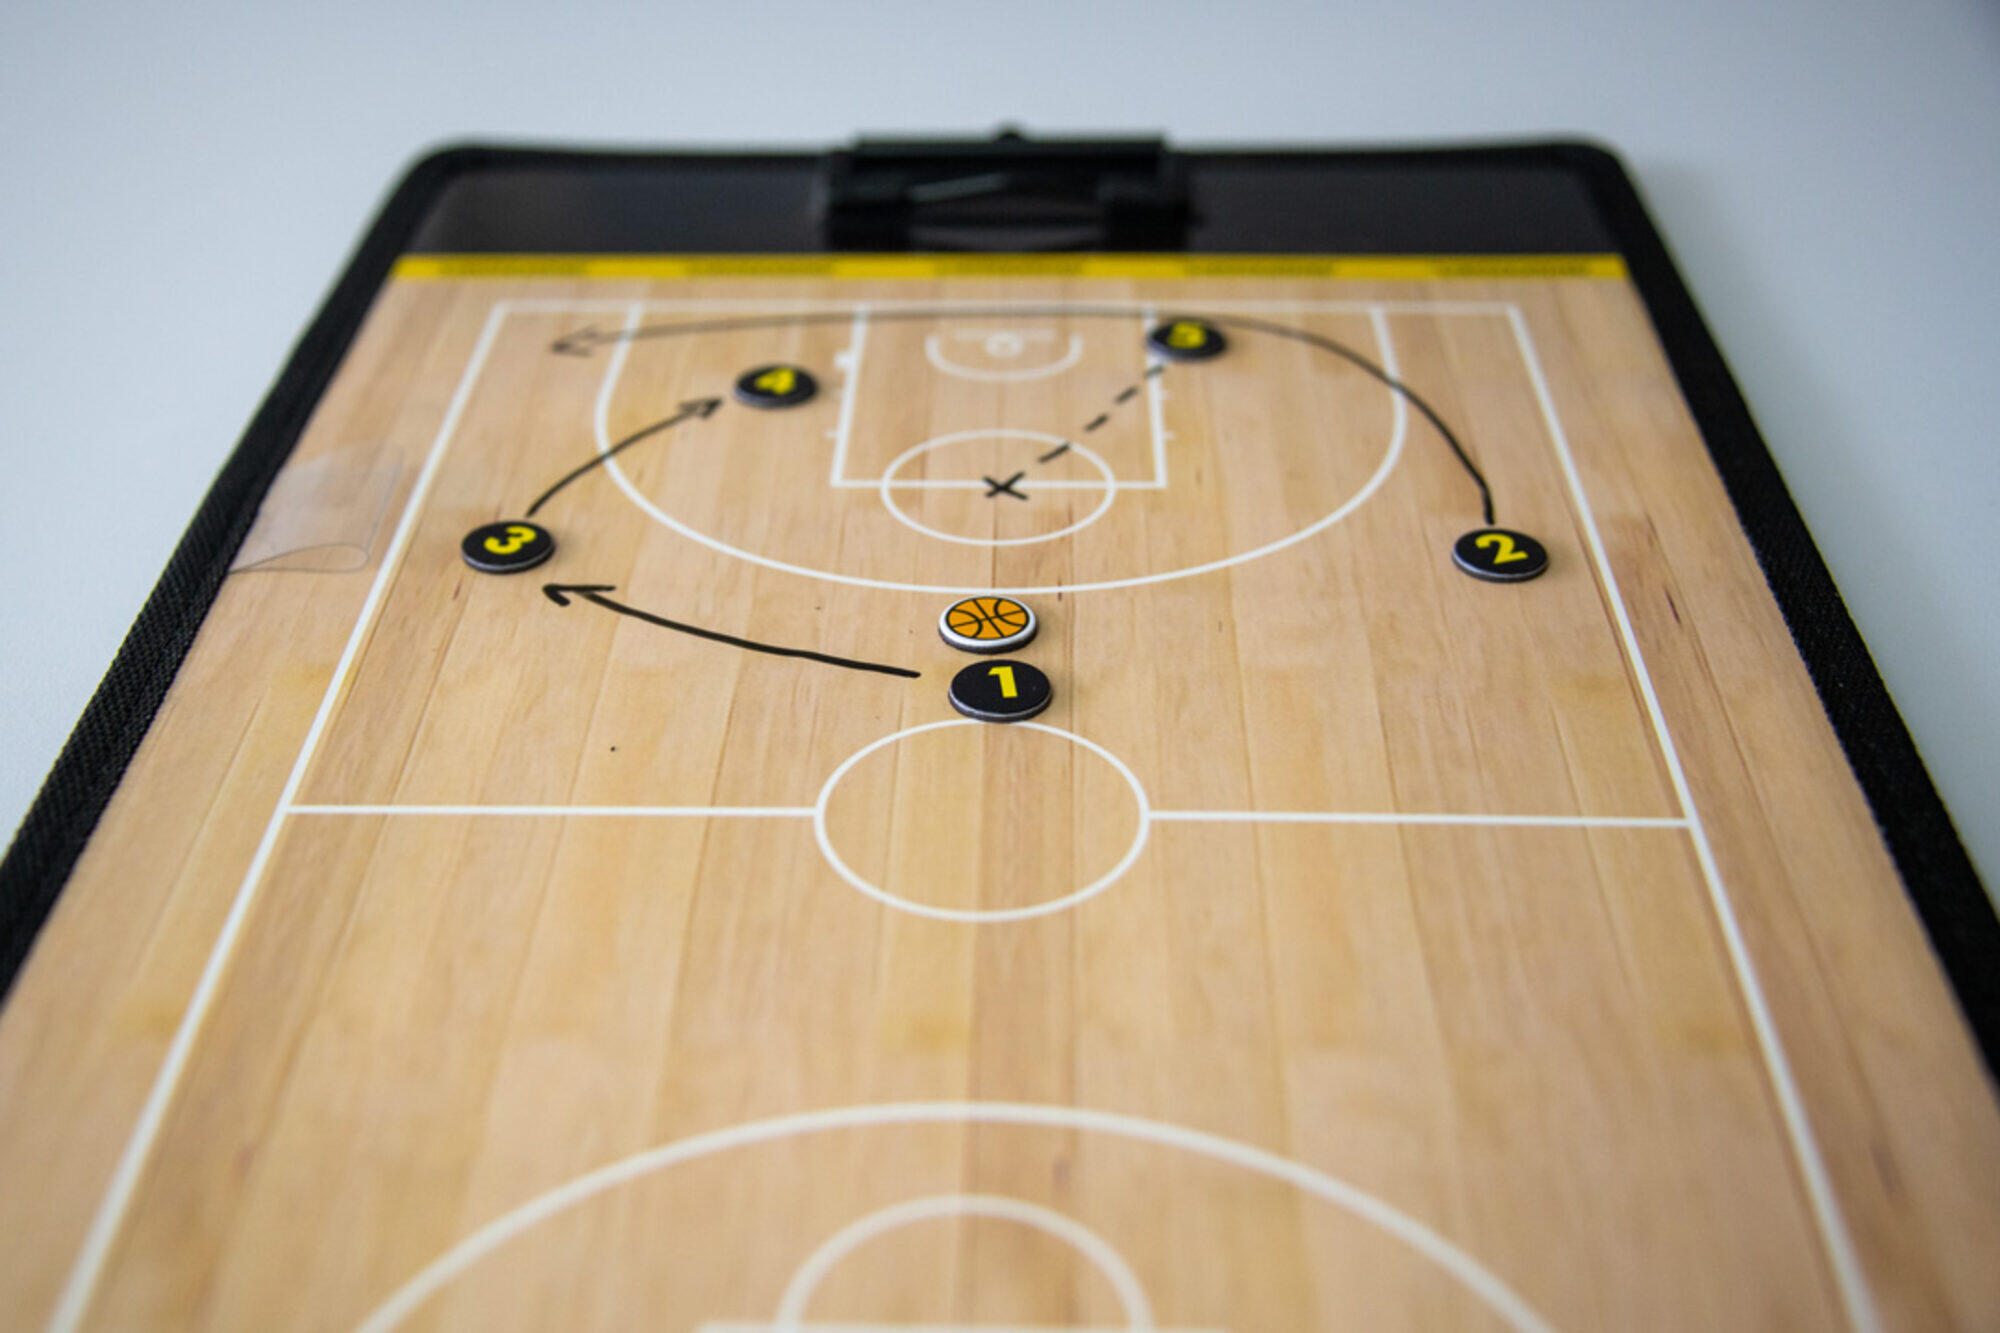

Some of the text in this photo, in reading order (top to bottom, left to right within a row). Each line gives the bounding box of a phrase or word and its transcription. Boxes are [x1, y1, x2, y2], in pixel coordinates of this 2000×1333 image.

[756, 367, 796, 395] 4
[483, 525, 537, 555] 3
[1475, 533, 1529, 565] 2
[988, 665, 1018, 699] 1
